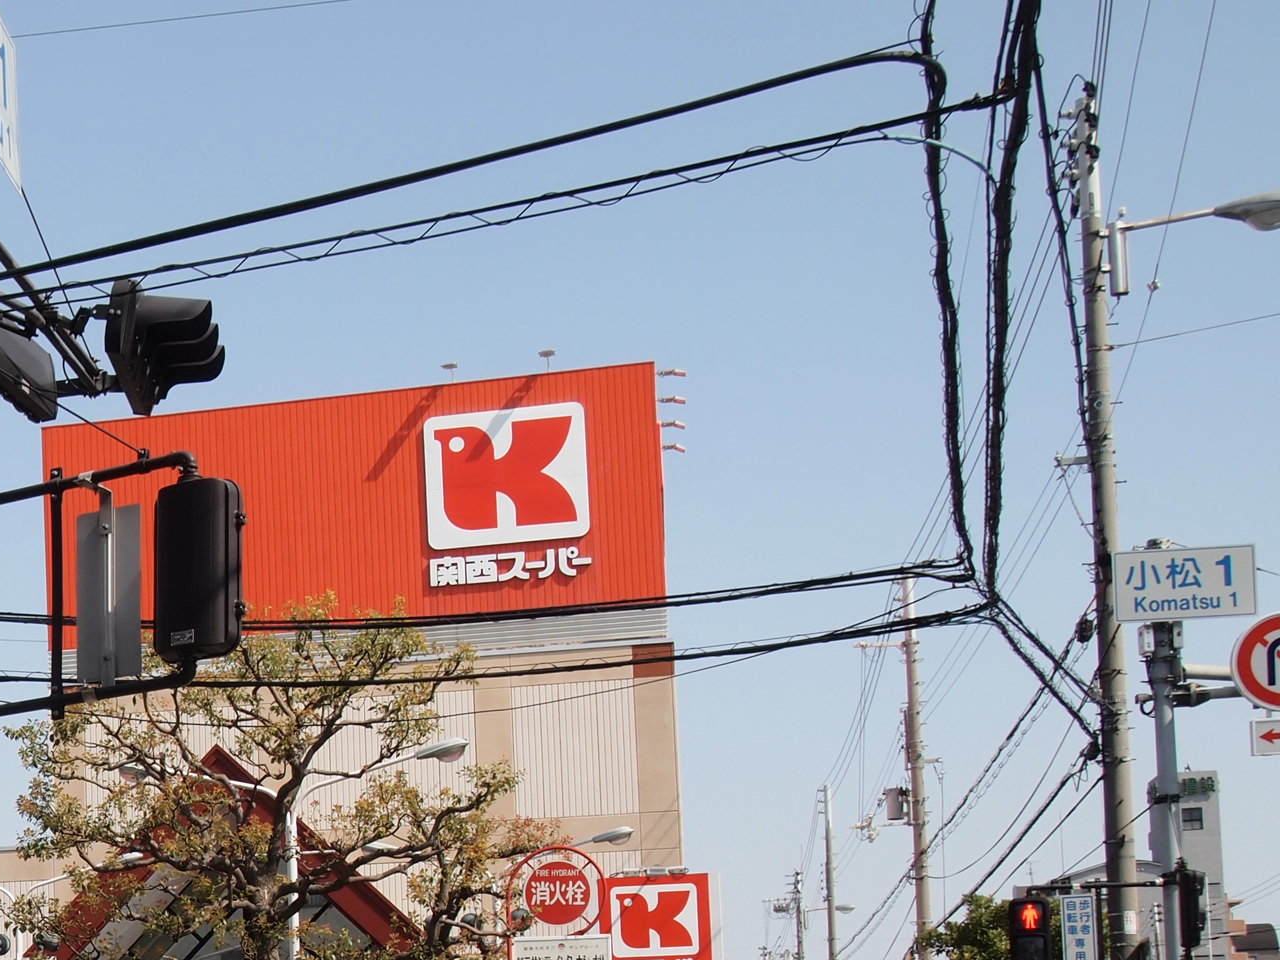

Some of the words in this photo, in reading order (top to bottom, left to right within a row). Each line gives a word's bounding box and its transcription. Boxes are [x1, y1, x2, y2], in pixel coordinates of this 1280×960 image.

[429, 546, 593, 588] 関西スーパー
[1125, 557, 1202, 591] 小松
[1216, 554, 1234, 587] 1
[1134, 596, 1221, 613] Komatsu
[1229, 592, 1238, 607] 1
[535, 869, 550, 877] FIRE
[551, 868, 580, 877] HYDRANT
[530, 881, 586, 906] 消火栓
[1066, 901, 1079, 935] 自転車
[1079, 900, 1091, 935] 歩行者
